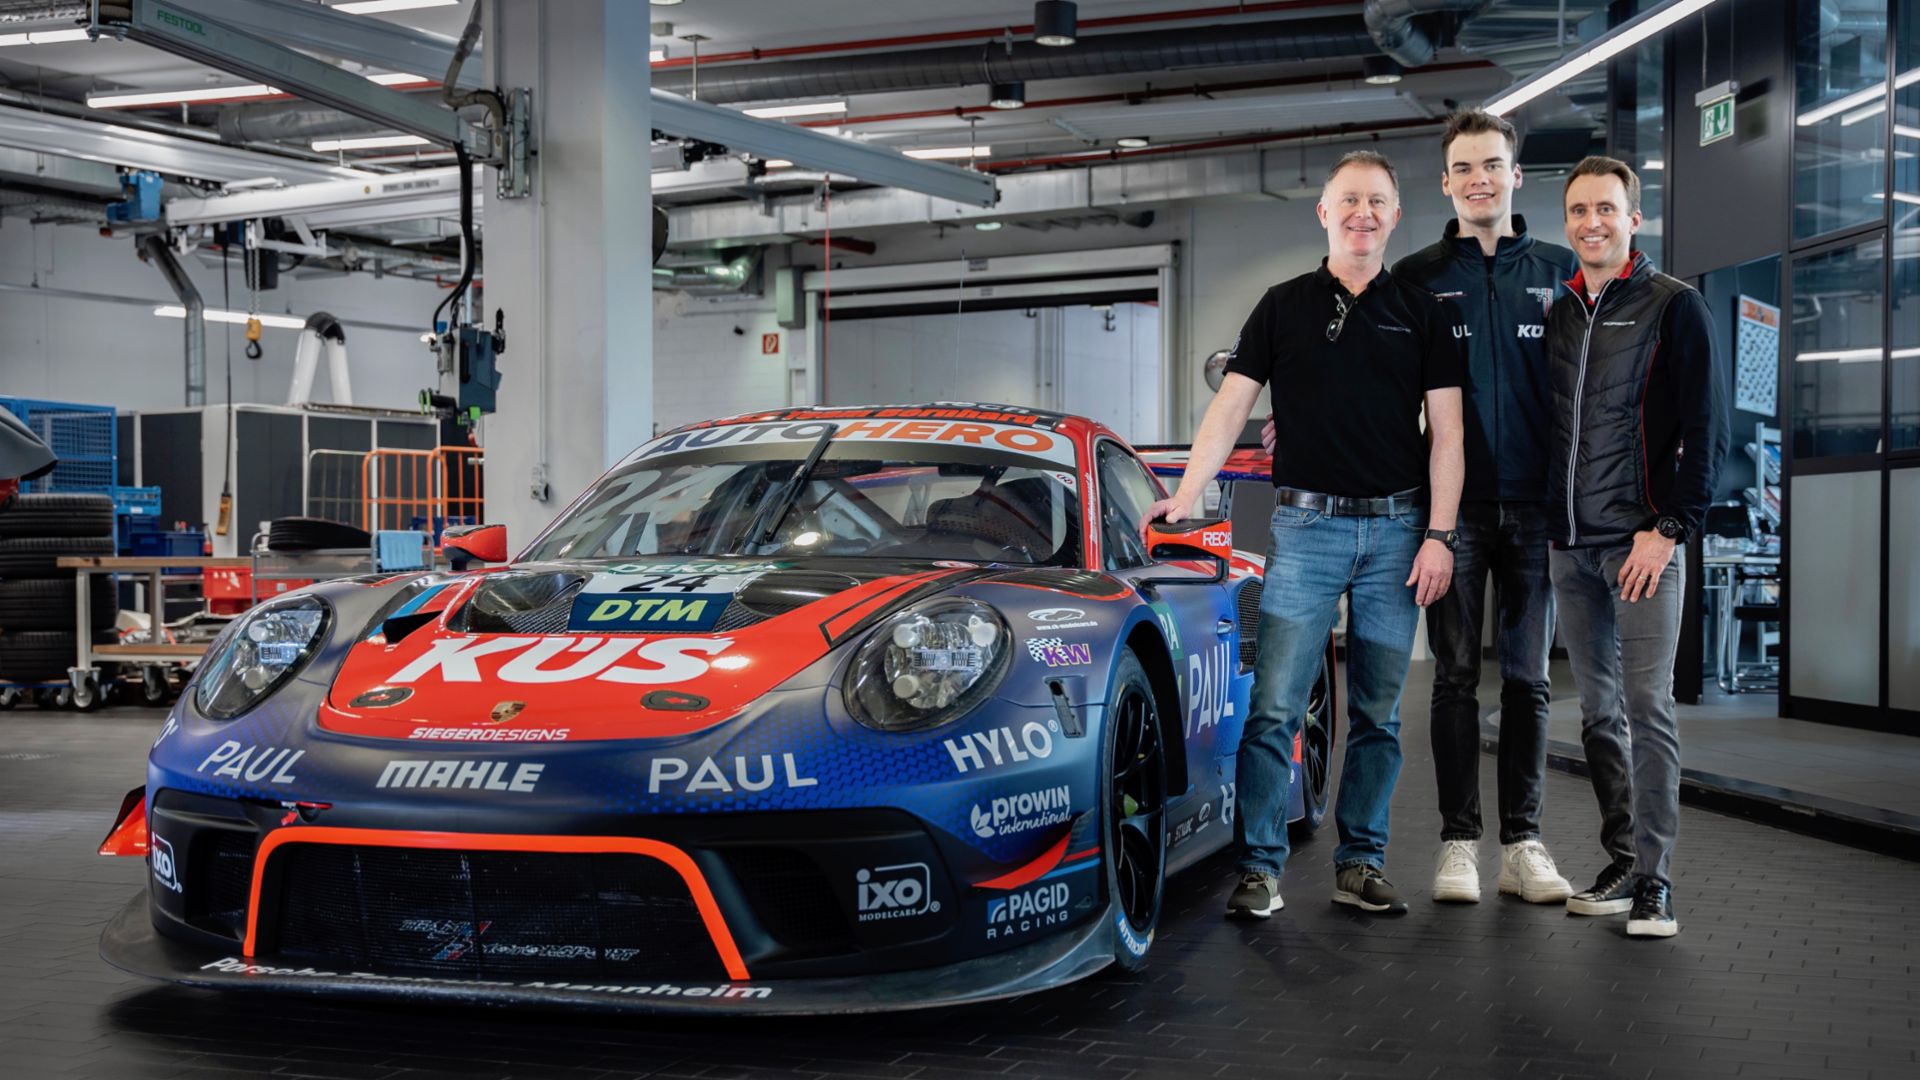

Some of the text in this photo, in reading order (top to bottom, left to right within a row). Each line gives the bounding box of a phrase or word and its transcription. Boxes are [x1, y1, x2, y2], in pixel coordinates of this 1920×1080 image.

[157, 9, 207, 36] FESTOOL
[1452, 324, 1472, 338] UL
[1517, 324, 1545, 338] KÜ
[634, 421, 1054, 461] AUTOHERO
[1202, 530, 1232, 548] RECAR
[608, 562, 777, 575] DEKRA
[618, 573, 720, 593] 24
[587, 599, 709, 622] DTM
[384, 636, 736, 685] KÜS
[1041, 643, 1092, 668] KW
[1185, 640, 1234, 740] PAUL
[408, 727, 571, 741] SIEGERDESIGNS
[197, 739, 306, 784] PAUL
[648, 753, 818, 794] PAUL
[375, 760, 546, 792] MAHLE
[998, 806, 1072, 836] international
[858, 908, 918, 922] MODELCARS
[1009, 883, 1070, 920] PAGID
[987, 910, 1069, 940] RACING
[200, 957, 337, 977] Porsche
[519, 981, 773, 999] Mannheim
